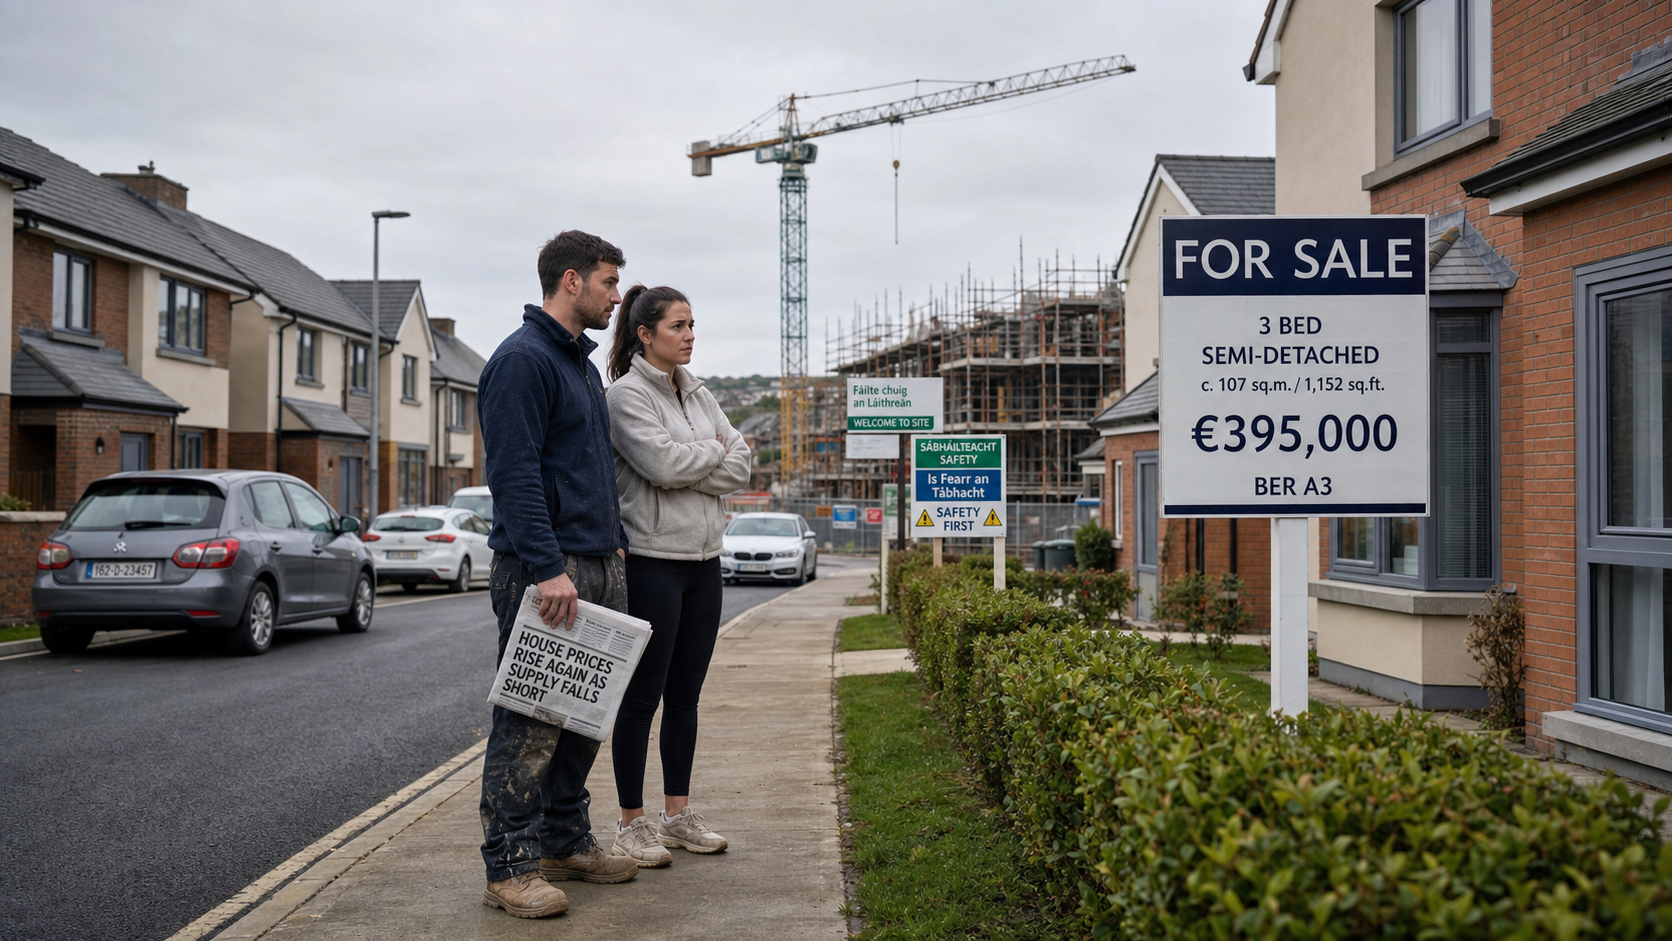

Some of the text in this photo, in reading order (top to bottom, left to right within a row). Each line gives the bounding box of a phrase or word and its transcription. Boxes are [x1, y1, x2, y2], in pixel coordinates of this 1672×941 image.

[1175, 238, 1413, 280] FOR SALE
[1259, 316, 1322, 335] 3 BED
[1202, 346, 1380, 365] SEMI-DETACHED
[853, 385, 908, 398] Fáilte chuig
[1201, 376, 1385, 395] c. 107 sq.m. / 1,152 sq.ft.
[853, 399, 865, 408] an
[853, 418, 930, 428] WELCOME TO SITE
[920, 440, 997, 452] SÁBHÁILTEACHT
[1191, 414, 1398, 459] €395,000
[940, 454, 978, 465] SAFETY
[928, 473, 989, 485] Is Fearr an
[1254, 476, 1332, 496] BER A3
[931, 486, 985, 498] Tábhacht
[936, 507, 981, 518] SAFETY
[943, 521, 975, 531] FIRST
[518, 630, 566, 658] HOUSE
[565, 647, 614, 675] PRICES
[513, 647, 608, 690] RISE AGAIN AS
[502, 678, 549, 703] SHORT
[508, 663, 561, 690] SUPPLY
[560, 680, 600, 704] FALLS
